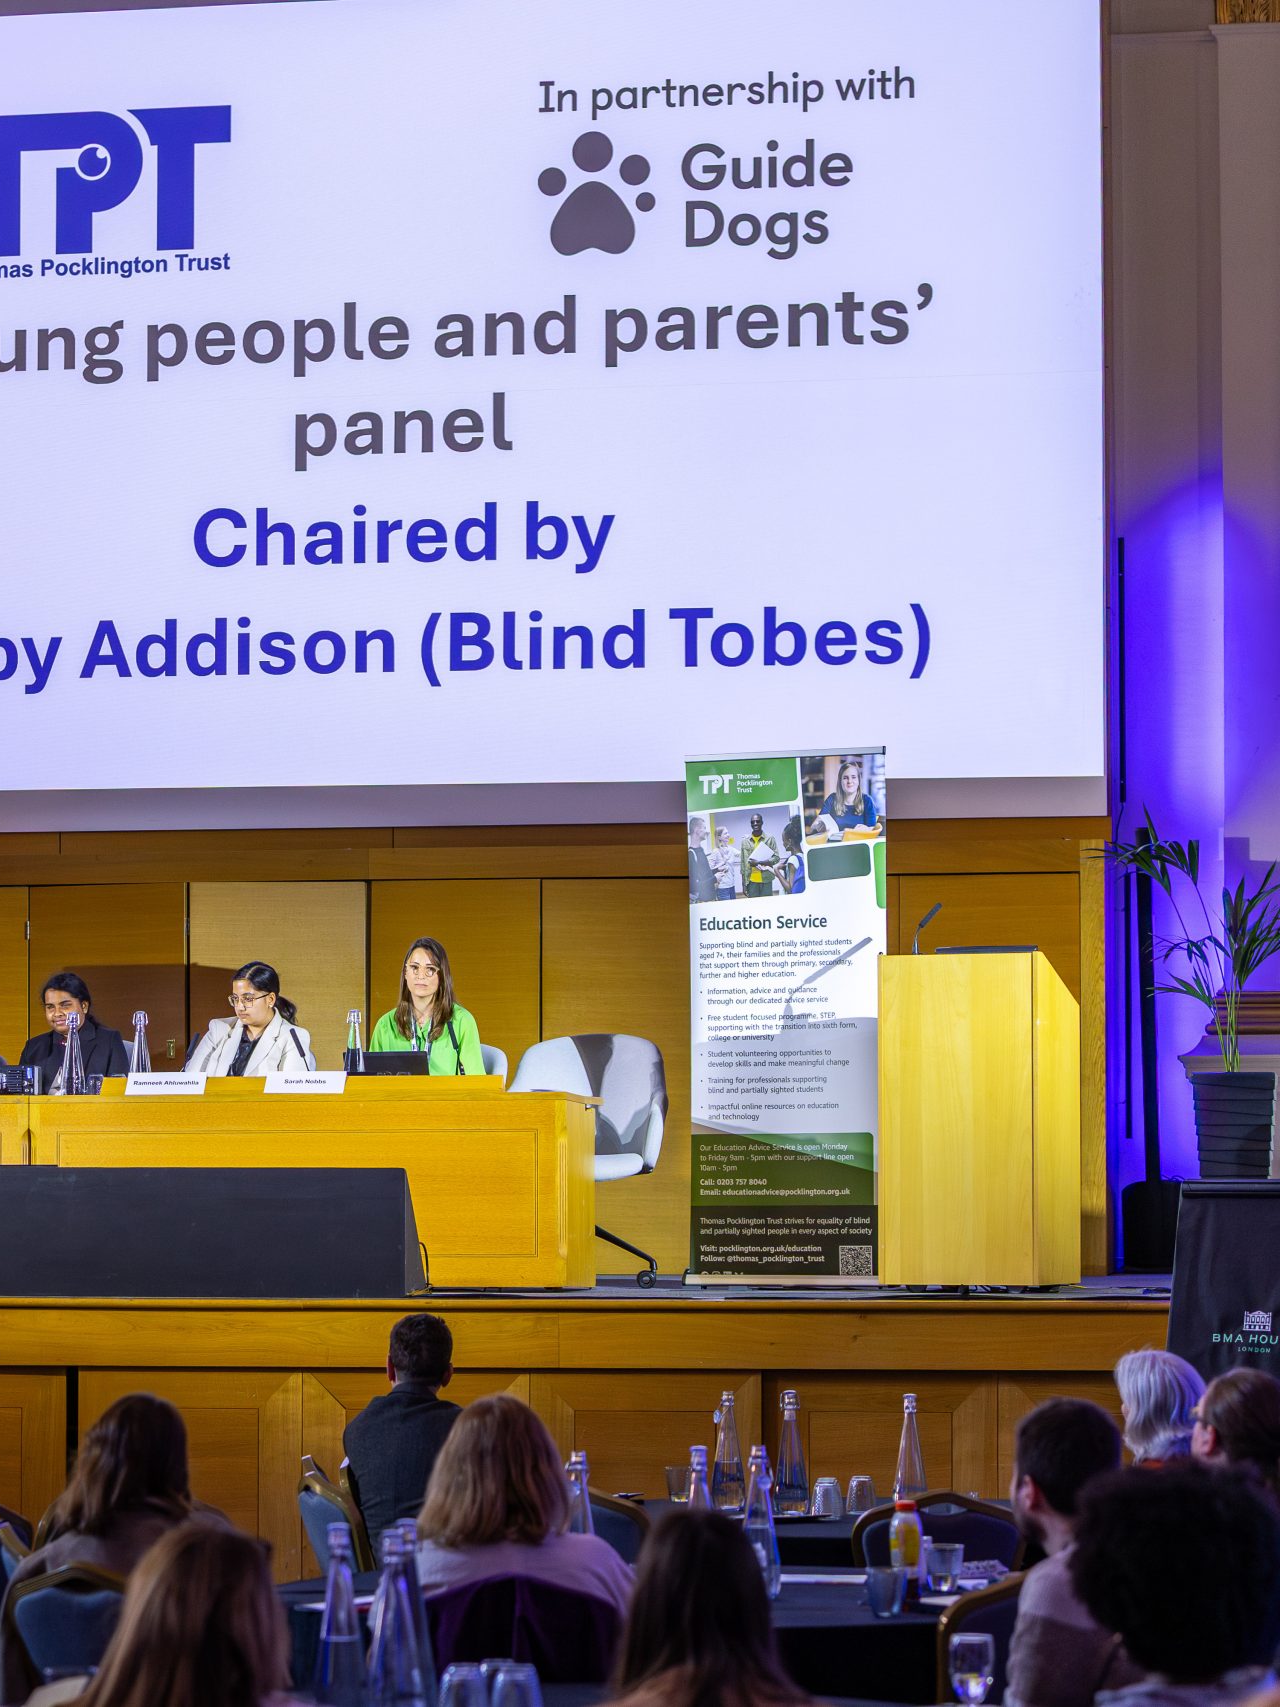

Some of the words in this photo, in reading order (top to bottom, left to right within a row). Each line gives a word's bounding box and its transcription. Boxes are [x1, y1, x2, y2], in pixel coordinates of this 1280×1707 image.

[539, 80, 578, 113] In
[592, 72, 823, 120] partnership
[836, 66, 915, 101] with
[681, 138, 853, 191] Guide
[686, 200, 828, 260] Dogs
[40, 256, 168, 278] Pocklington
[174, 252, 230, 272] Trust
[147, 302, 410, 381] people
[434, 295, 576, 358] and
[606, 283, 932, 368] parents’
[295, 392, 513, 472] panel
[194, 502, 497, 568] Chaired
[526, 501, 614, 574] by
[81, 617, 394, 678] Addison
[421, 608, 645, 687] (Blind
[669, 603, 930, 679] Tobes)
[698, 774, 733, 794] TPT
[736, 779, 773, 787] Pocklington
[699, 915, 771, 931] Education
[776, 914, 827, 929] Service
[699, 942, 735, 950] Supporting
[736, 940, 754, 948] blind
[755, 940, 768, 948] and
[770, 939, 797, 948] partially
[799, 939, 823, 948] sighted
[824, 938, 852, 946] students
[699, 951, 715, 960] aged
[744, 950, 771, 958] families
[771, 950, 785, 958] and
[786, 949, 798, 957] the
[799, 948, 842, 958] professionals
[713, 961, 740, 969] support
[741, 960, 760, 968] them
[761, 960, 789, 968] through
[699, 971, 721, 979] further
[737, 970, 760, 979] higher
[761, 970, 796, 978] education.
[707, 987, 748, 995] Information,
[773, 986, 786, 994] and
[787, 986, 818, 995] guidance
[707, 997, 734, 1006] through
[784, 996, 805, 1005] advice
[806, 995, 828, 1003] service
[707, 1050, 733, 1058] Student
[734, 1049, 777, 1058] volunteering
[779, 1048, 823, 1058] opportunities
[707, 1060, 734, 1068] develop
[752, 1059, 766, 1067] and
[767, 1059, 786, 1067] make
[788, 1058, 824, 1067] meaningful
[825, 1058, 850, 1066] change
[707, 1077, 734, 1085] Training
[747, 1075, 791, 1085] professionals
[792, 1075, 827, 1084] supporting
[707, 1086, 724, 1094] blind
[725, 1086, 739, 1094] and
[740, 1086, 768, 1095] partially
[770, 1085, 794, 1094] sighted
[796, 1085, 824, 1093] students
[708, 1102, 740, 1111] Impactful
[741, 1102, 762, 1110] online
[708, 1113, 720, 1122] and
[722, 1113, 760, 1122] technology
[699, 1178, 715, 1186] Call:
[716, 1178, 734, 1186] 0203
[699, 1188, 721, 1196] Email:
[699, 1217, 726, 1225] Thomas
[726, 1217, 765, 1226] Pocklington
[805, 1216, 816, 1224] for
[816, 1216, 844, 1226] equality
[844, 1216, 852, 1224] of
[853, 1216, 870, 1224] blind
[713, 1227, 741, 1236] partially
[741, 1227, 766, 1236] sighted
[767, 1226, 790, 1236] people
[798, 1228, 817, 1236] every
[817, 1227, 839, 1236] aspect
[840, 1226, 848, 1234] of
[848, 1226, 872, 1236] society
[699, 1244, 718, 1252] Visit:
[700, 1254, 726, 1262] Follow:
